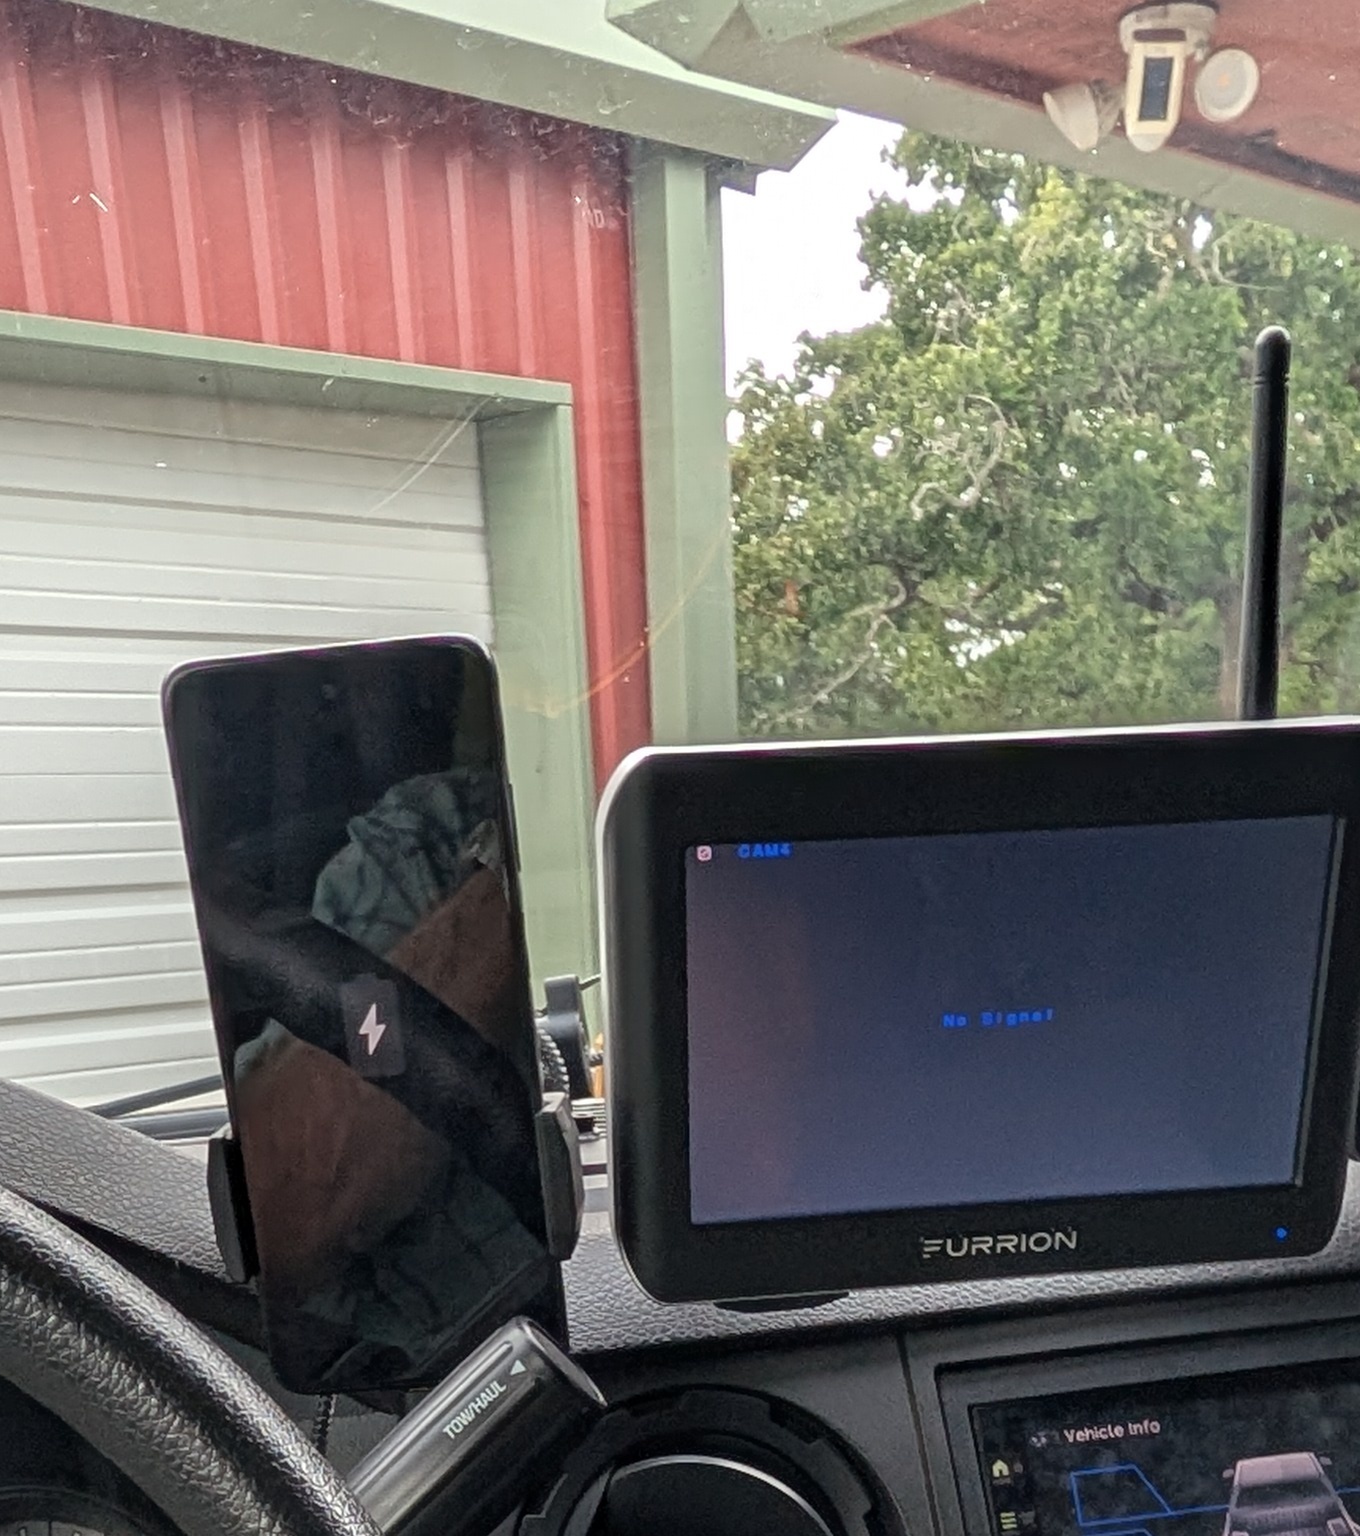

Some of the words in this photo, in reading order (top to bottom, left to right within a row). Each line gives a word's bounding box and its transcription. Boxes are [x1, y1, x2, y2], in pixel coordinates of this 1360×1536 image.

[943, 1014, 967, 1027] No
[981, 1008, 1053, 1027] Signal
[921, 1227, 1077, 1259] FURRION
[443, 1380, 507, 1439] TOW/HAUL
[1064, 1424, 1124, 1443] Vehicle
[1127, 1420, 1161, 1436] Info
